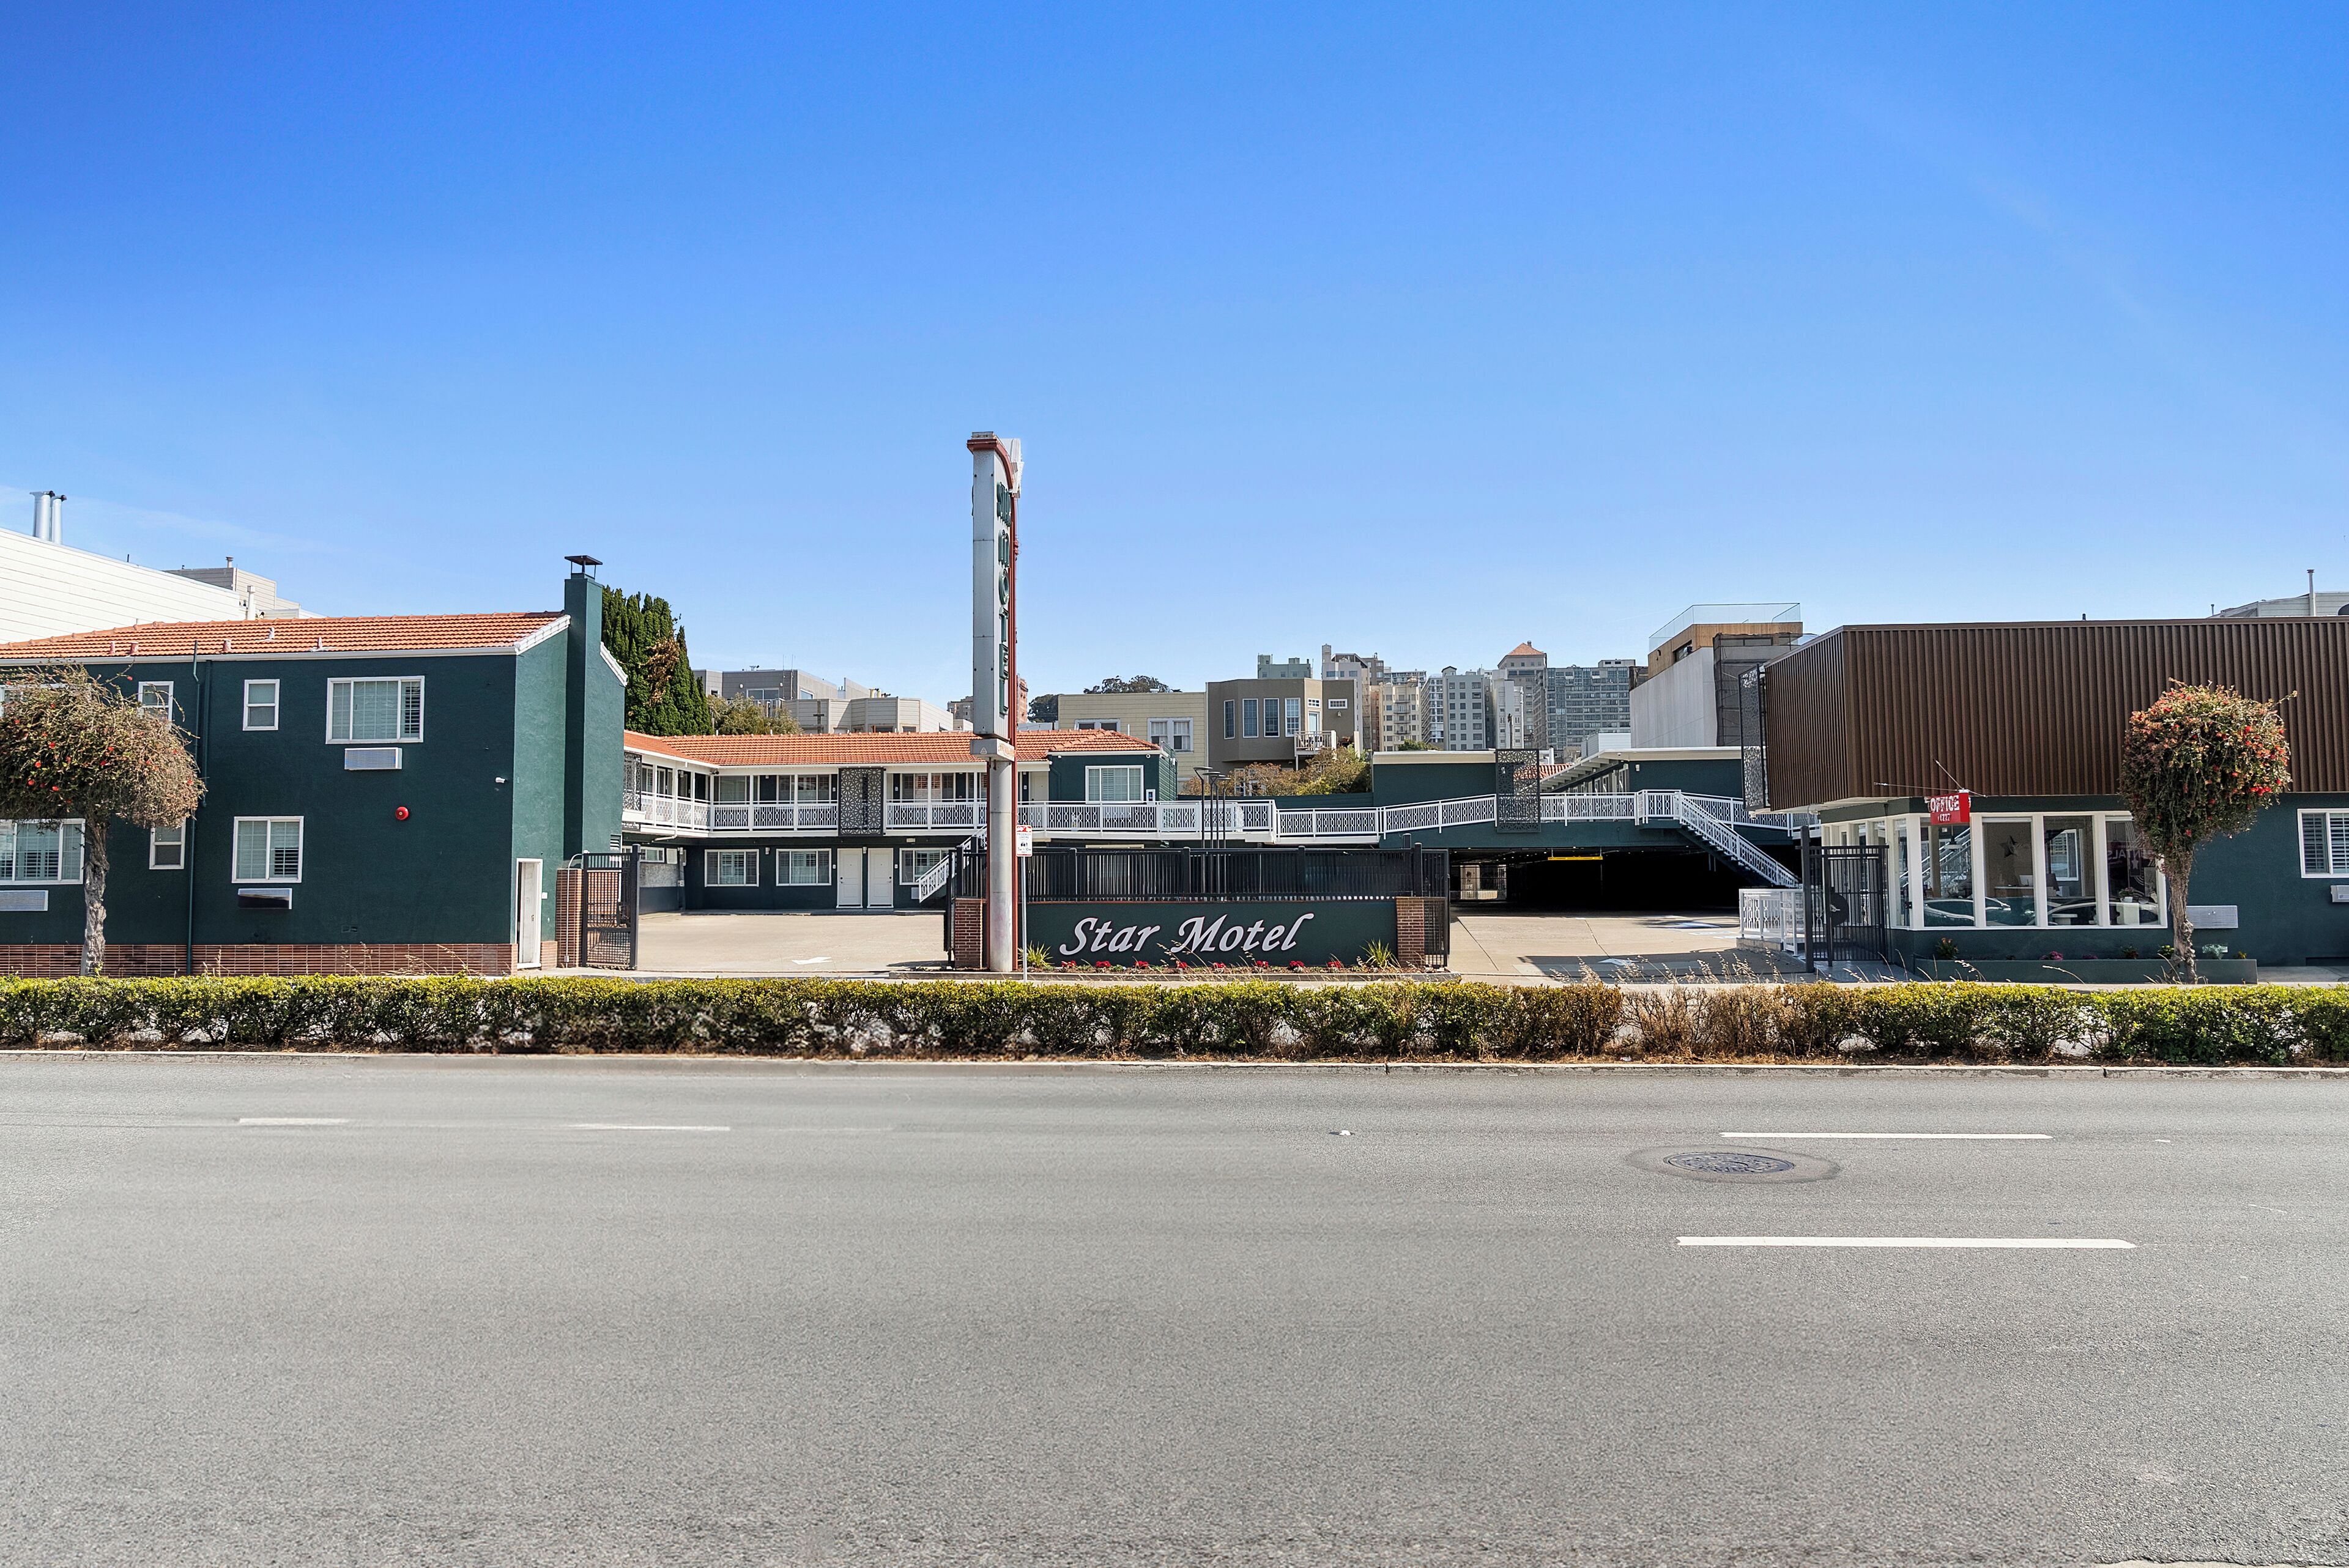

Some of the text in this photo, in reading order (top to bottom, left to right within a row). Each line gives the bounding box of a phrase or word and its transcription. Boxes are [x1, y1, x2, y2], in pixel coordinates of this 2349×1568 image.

[998, 529, 1009, 717] MOTEL
[1930, 795, 1959, 813] OFFICE
[1059, 913, 1315, 956] Star Motel
